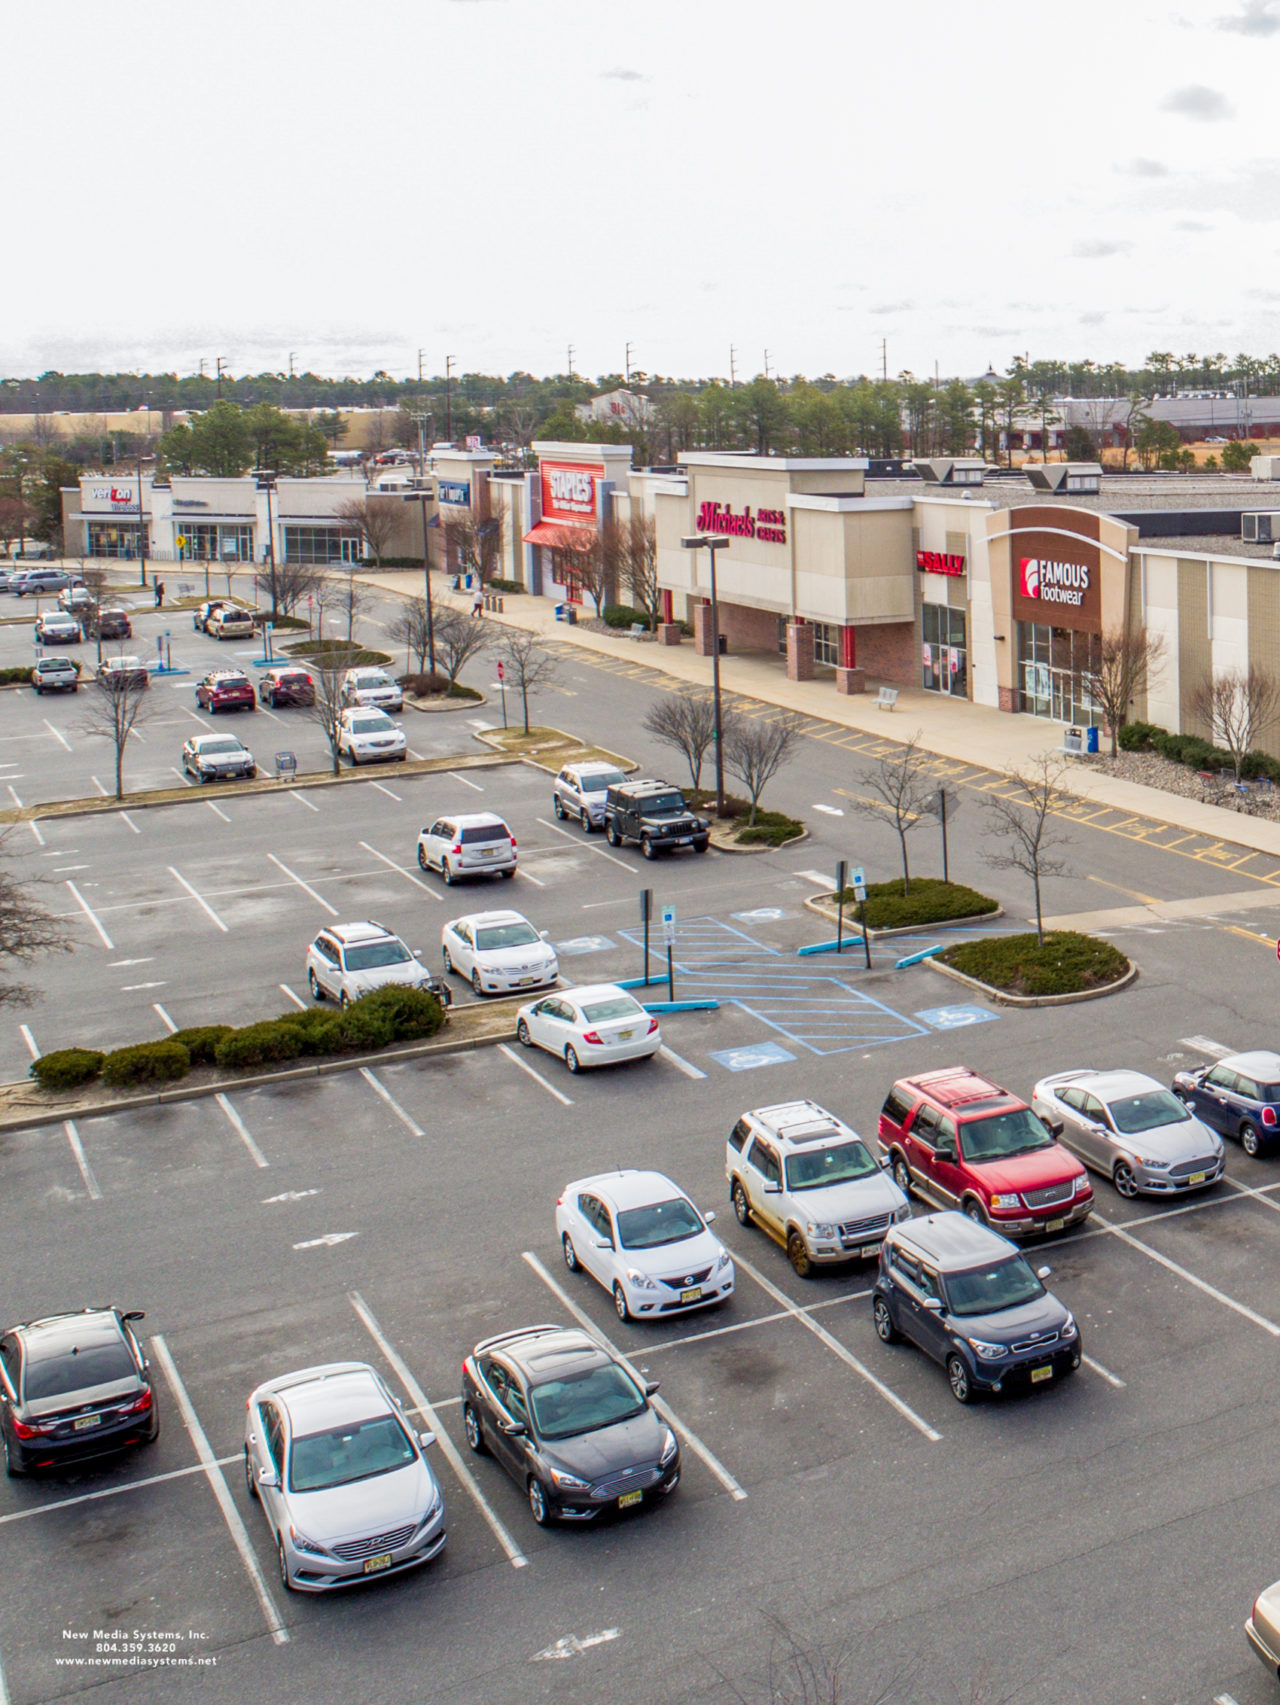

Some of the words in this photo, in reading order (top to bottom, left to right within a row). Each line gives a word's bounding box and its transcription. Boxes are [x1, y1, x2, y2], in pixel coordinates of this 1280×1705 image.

[92, 485, 131, 501] verizon
[550, 470, 592, 502] STAPLES
[697, 501, 755, 538] Michaels
[924, 551, 964, 573] SALLY
[1040, 560, 1089, 589] FAMOUS
[1040, 582, 1083, 606] footwear
